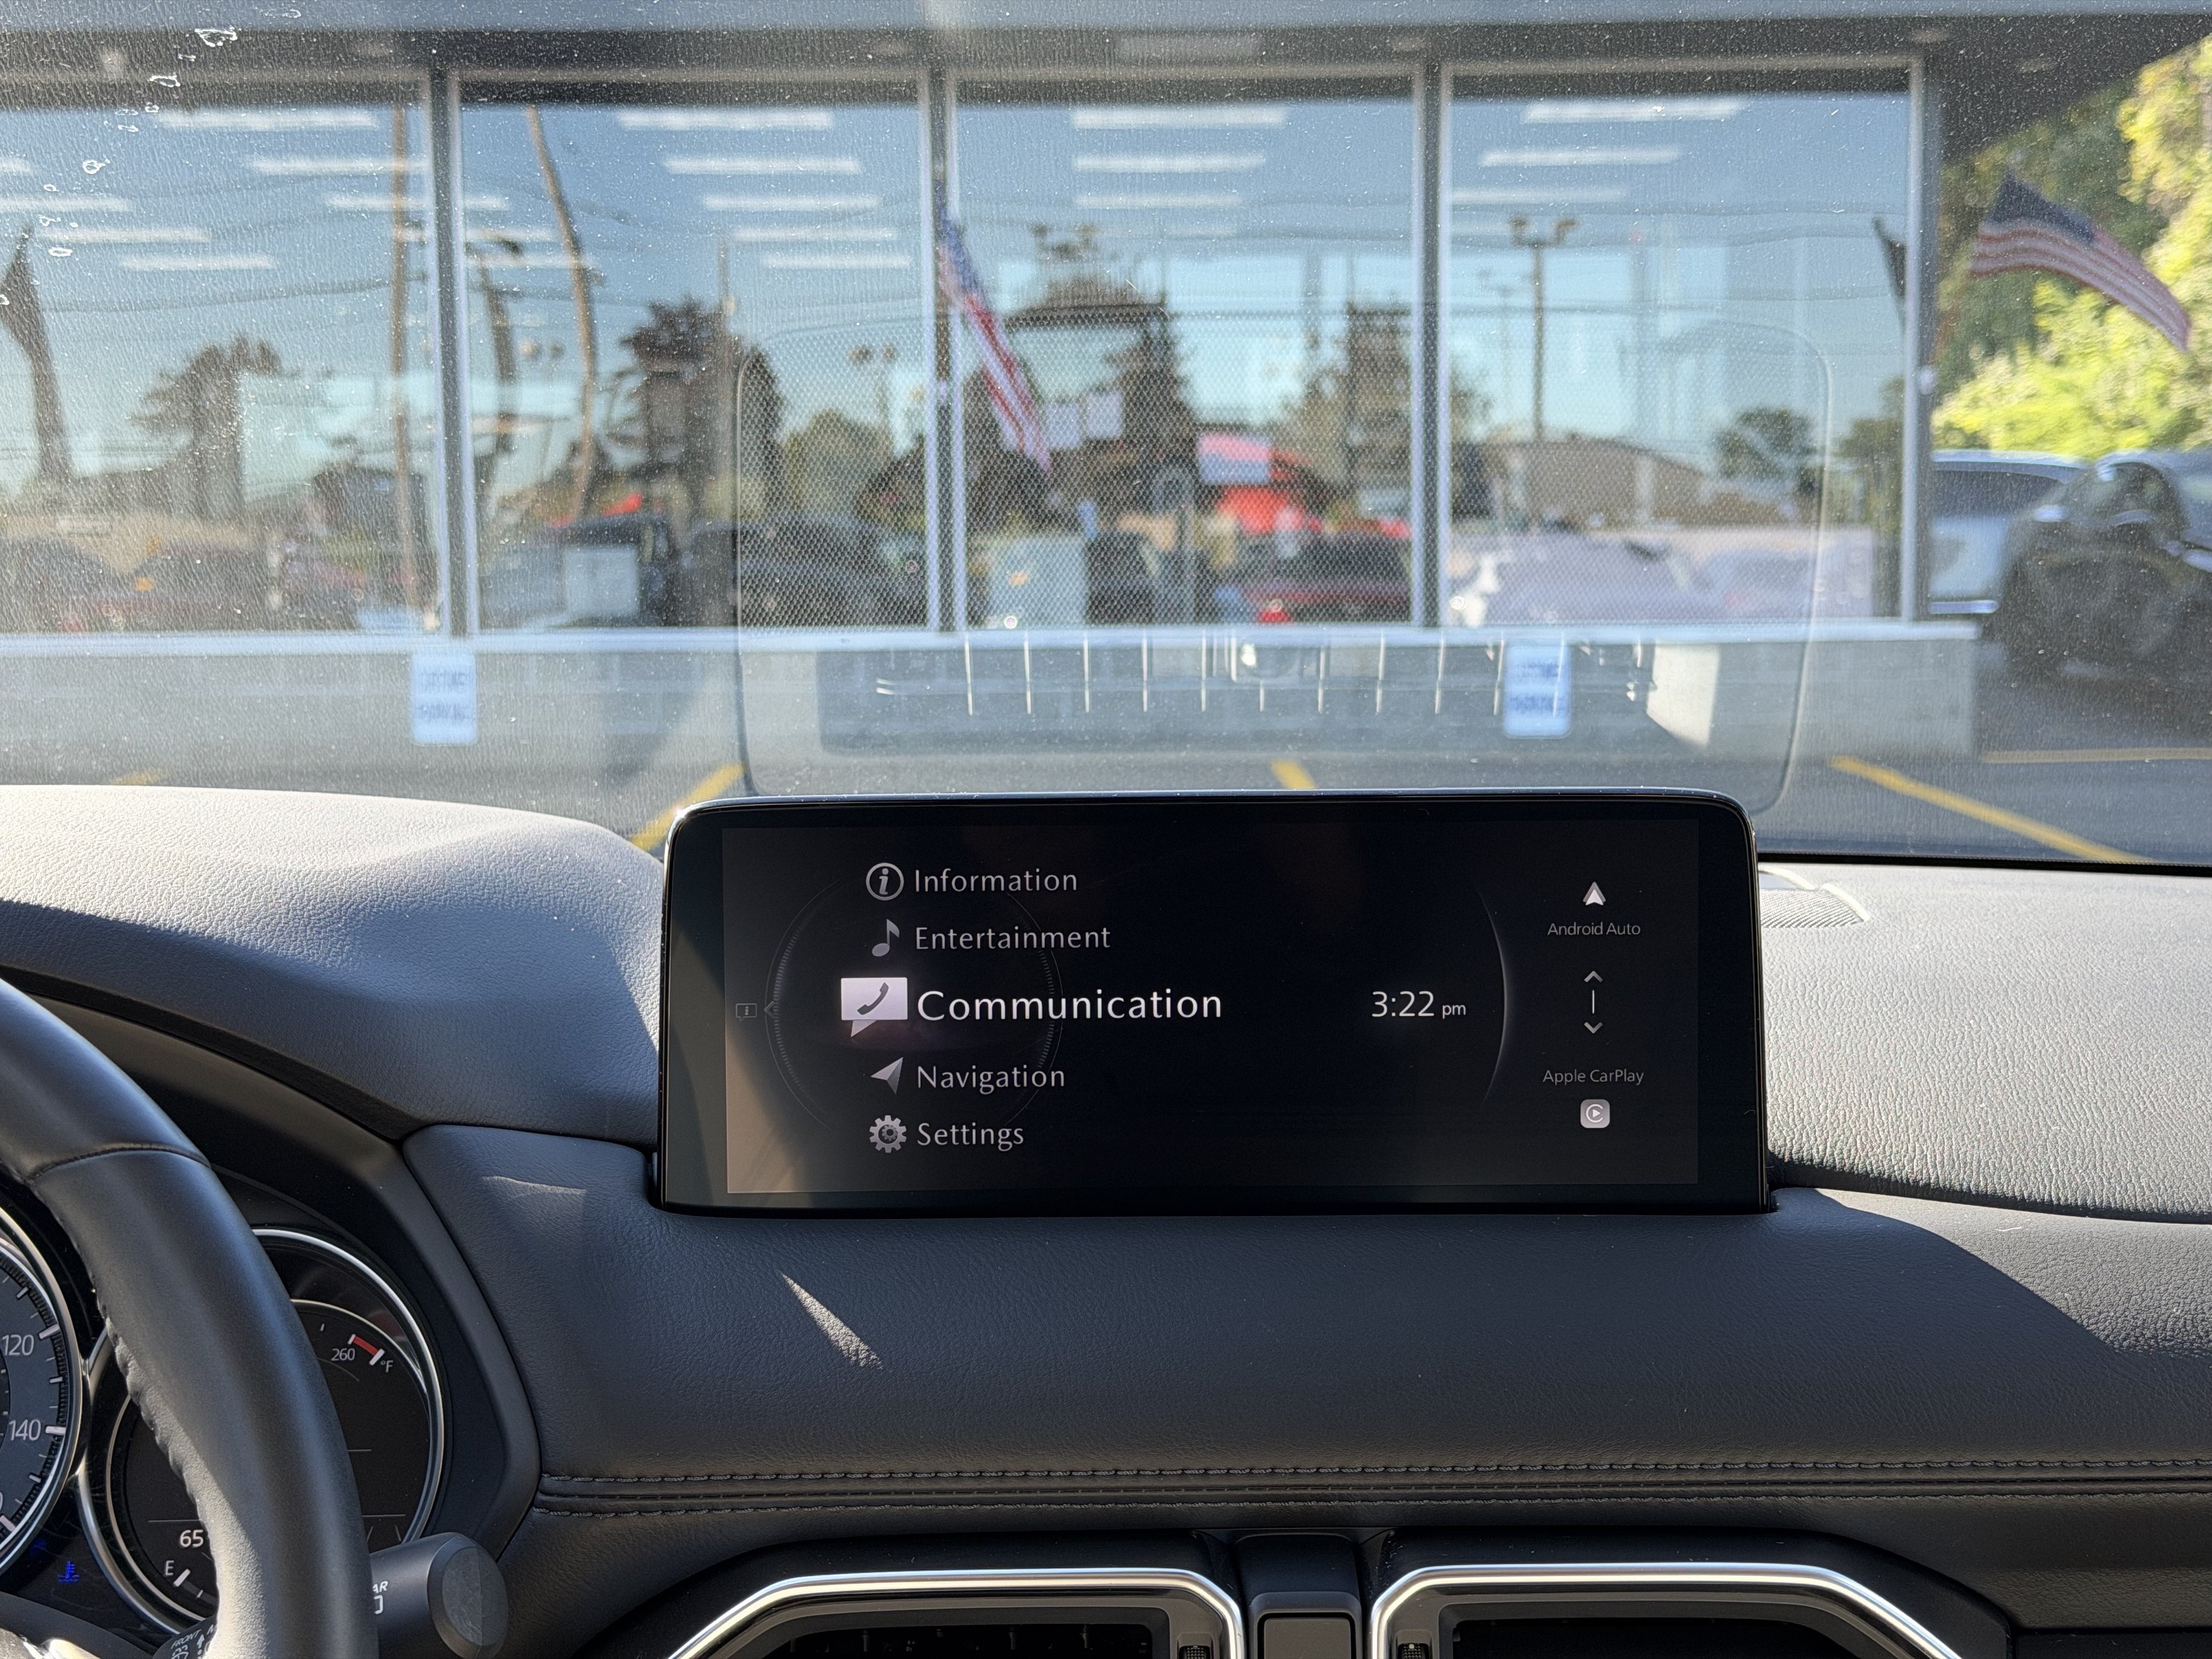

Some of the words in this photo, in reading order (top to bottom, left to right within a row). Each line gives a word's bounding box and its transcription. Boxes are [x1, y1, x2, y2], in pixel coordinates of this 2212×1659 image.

[915, 867, 1077, 893] Information
[916, 926, 1111, 950] Entertainment
[1547, 921, 1603, 935] Android
[1606, 922, 1641, 935] Auto
[917, 988, 1221, 1021] Communication
[1372, 991, 1435, 1017] 3:22
[1442, 1004, 1466, 1020] pm
[917, 1064, 1065, 1095] Navigation
[1543, 1069, 1586, 1086] Apple
[1590, 1068, 1644, 1086] CarPlay
[917, 1122, 1024, 1152] Settings
[2, 1334, 35, 1356] 120
[331, 1348, 356, 1361] 260
[9, 1419, 41, 1441] 140
[179, 1529, 204, 1548] 65
[165, 1560, 174, 1576] E
[373, 1581, 388, 1594] AR
[171, 1629, 202, 1649] FRONT
